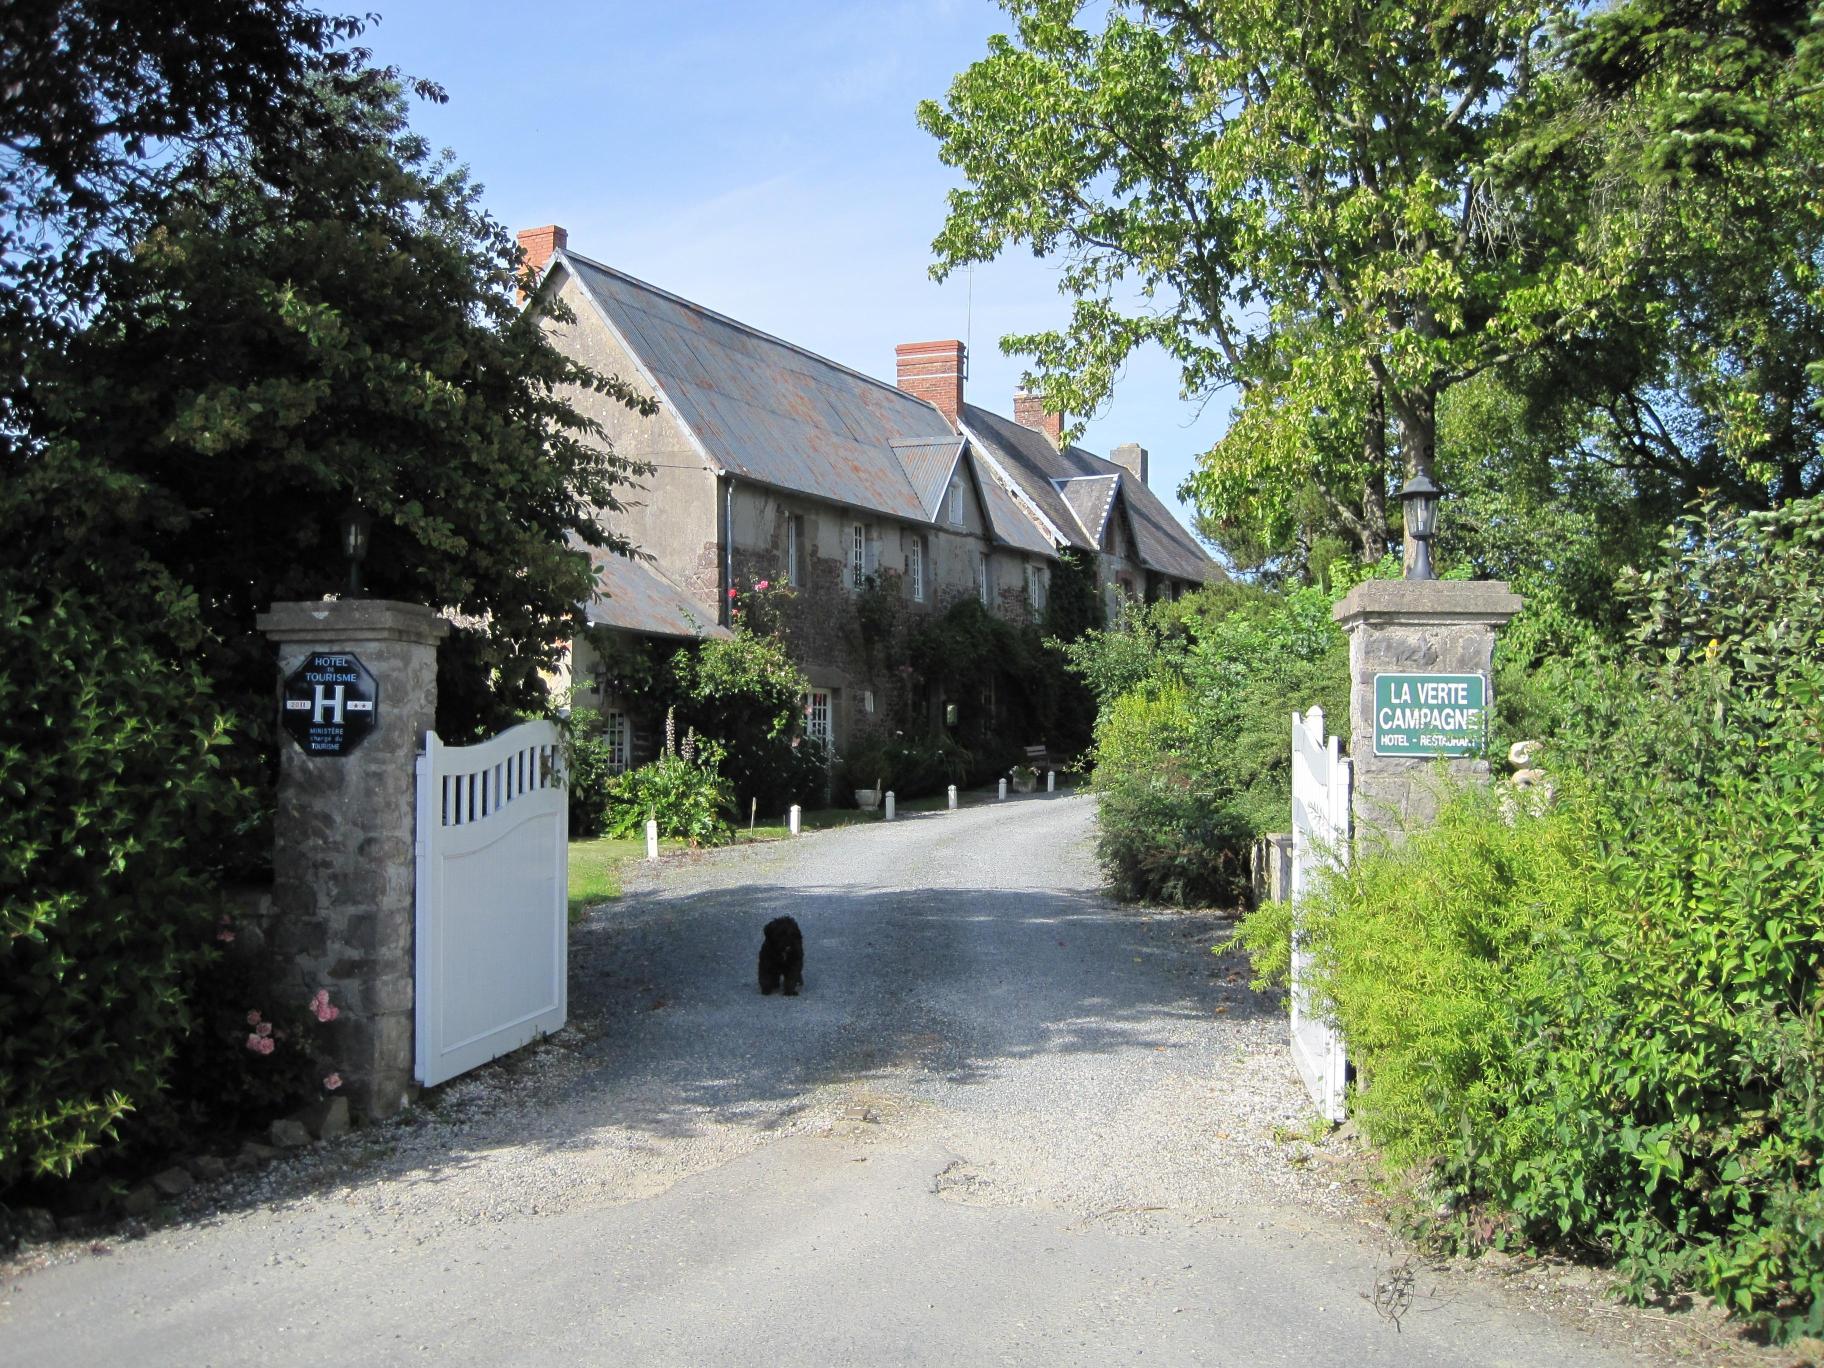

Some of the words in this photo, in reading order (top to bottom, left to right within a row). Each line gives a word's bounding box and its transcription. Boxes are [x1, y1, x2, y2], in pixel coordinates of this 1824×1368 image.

[315, 657, 347, 666] HOTEL
[306, 672, 357, 682] TOURISME
[1390, 682, 1412, 704] LA
[1417, 682, 1468, 705] VERTE
[313, 684, 345, 725] H
[1380, 735, 1409, 746] HOTEL
